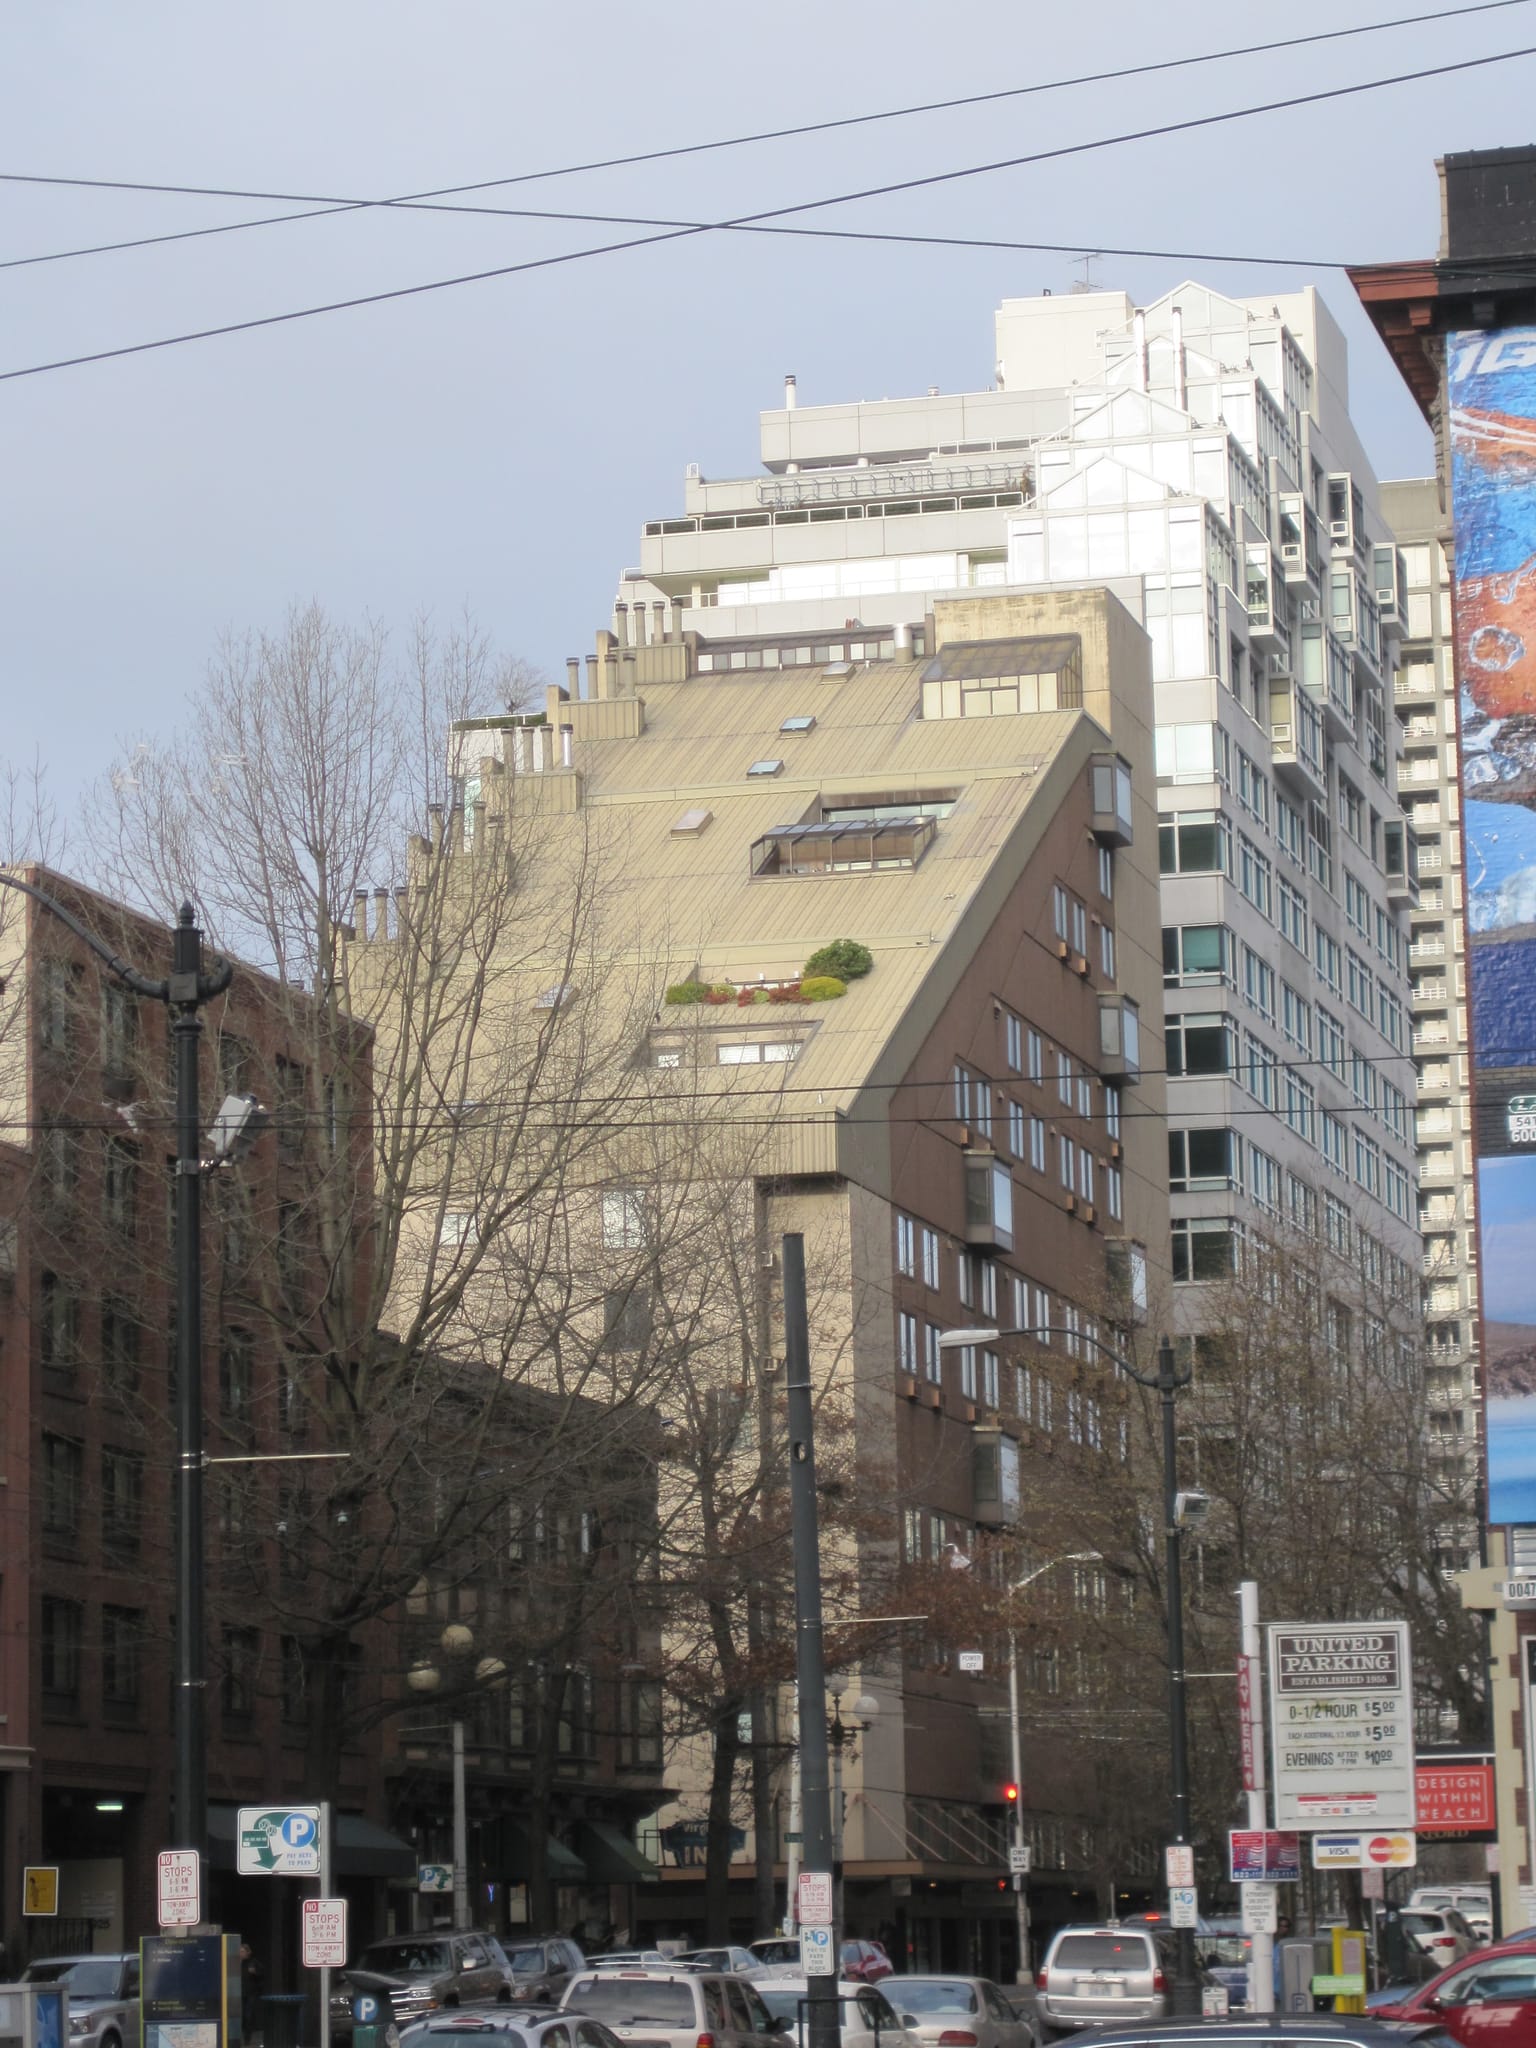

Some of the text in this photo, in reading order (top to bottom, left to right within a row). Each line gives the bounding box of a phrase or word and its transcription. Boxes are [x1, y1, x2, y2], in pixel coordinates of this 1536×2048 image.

[1293, 1637, 1383, 1653] UNITED
[1285, 1654, 1391, 1672] PARKING
[1238, 1658, 1248, 1702] PAY
[1291, 1677, 1364, 1686] ESTABLISHED
[1325, 1703, 1358, 1718] HOUR
[1241, 1708, 1252, 1768] HERE
[1286, 1751, 1334, 1766] EVENINGS
[1418, 1777, 1480, 1789] DESIGN
[1419, 1792, 1481, 1803] WITHIN
[1420, 1807, 1480, 1819] REACH
[290, 1818, 309, 1844] P
[1328, 1847, 1350, 1855] VISA
[164, 1867, 192, 1877] STOPS
[306, 1902, 317, 1912] NO
[309, 1914, 340, 1923] STOPS
